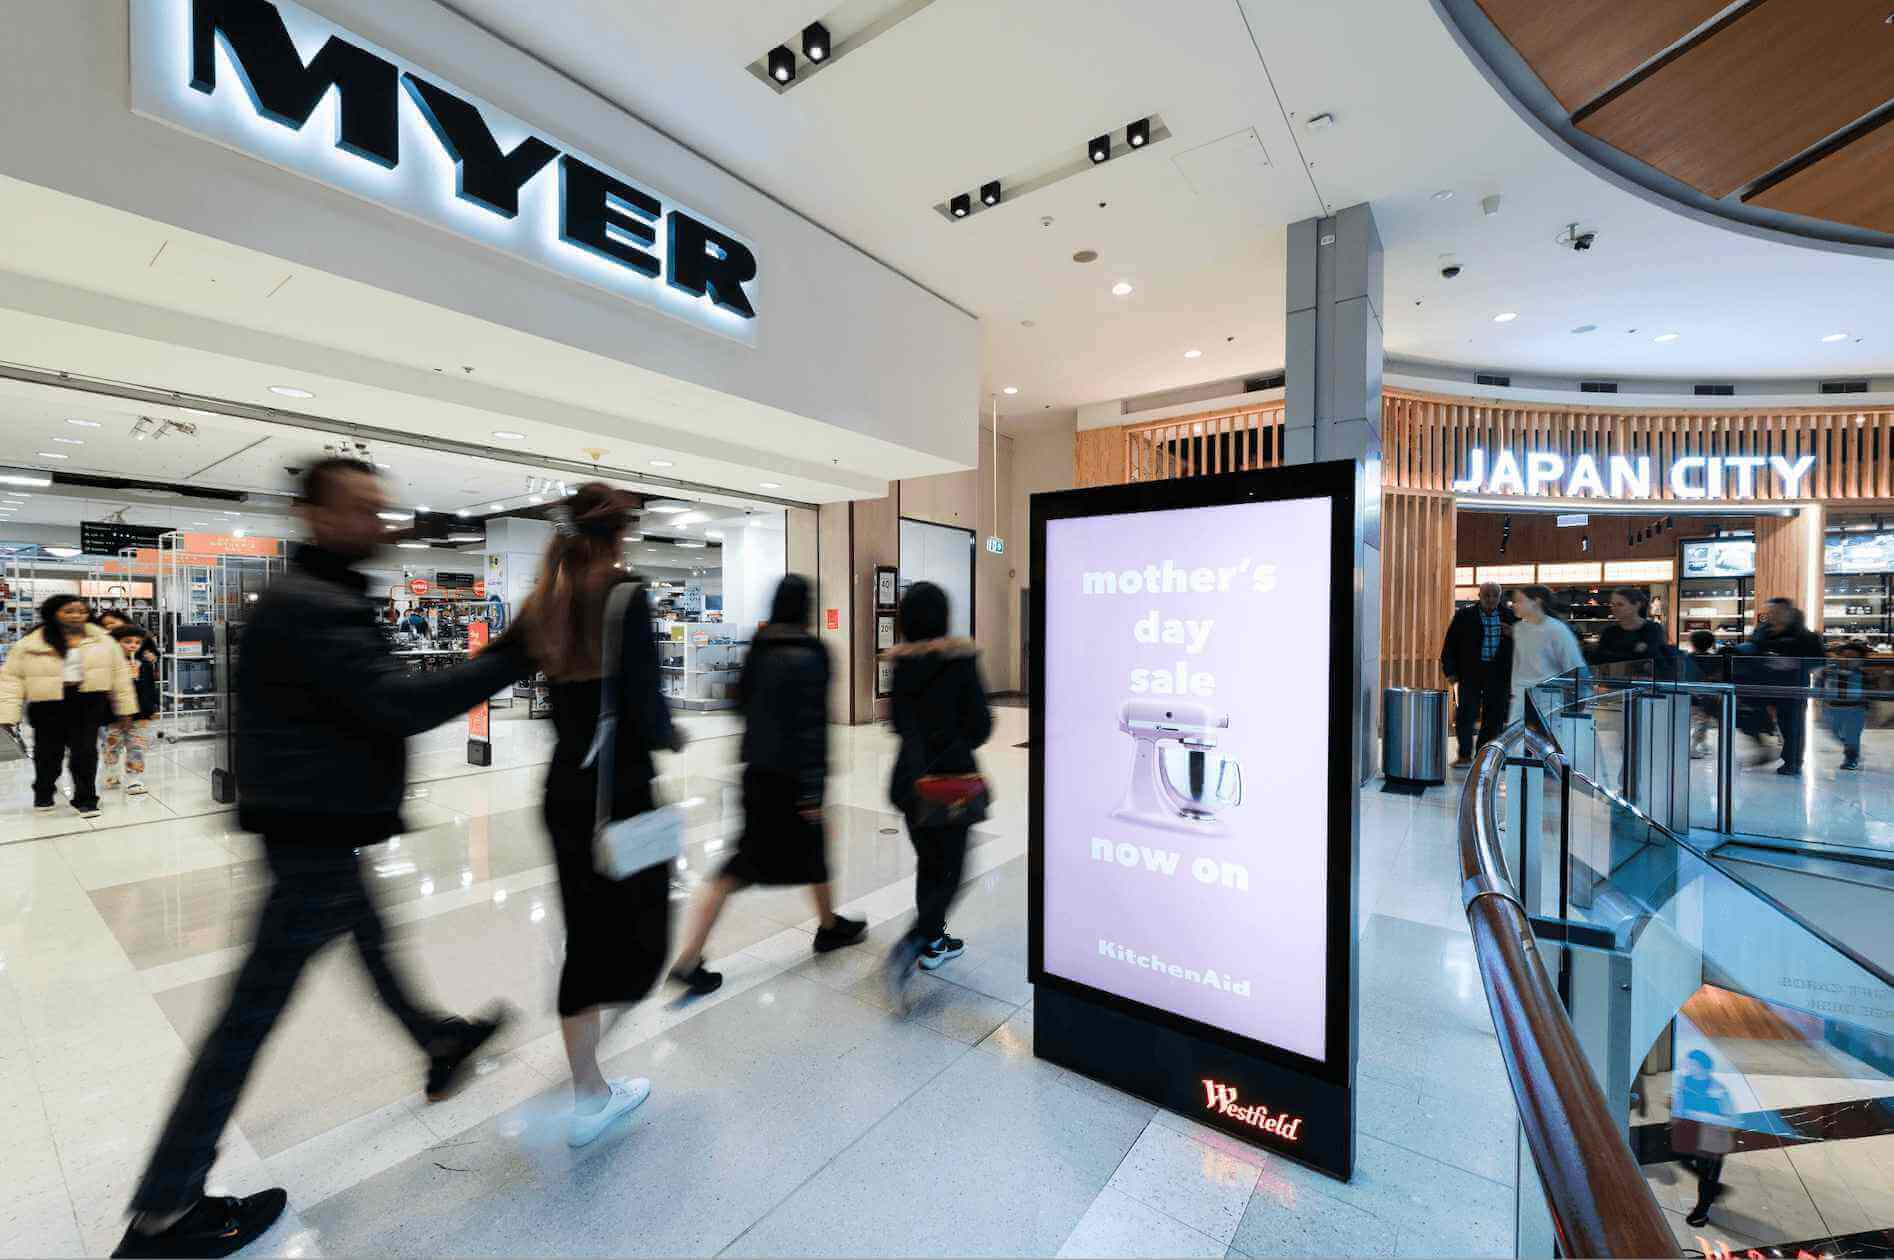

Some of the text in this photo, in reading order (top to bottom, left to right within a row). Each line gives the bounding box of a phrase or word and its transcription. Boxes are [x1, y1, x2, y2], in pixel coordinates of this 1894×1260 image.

[190, 0, 758, 319] MYER
[1453, 446, 1816, 500] JAPAN CITY
[1081, 557, 1278, 596] mother's
[1133, 610, 1215, 654] day
[1130, 662, 1216, 696] sale
[1090, 836, 1249, 892] now on
[1097, 938, 1252, 999] KitchenAid
[1201, 1078, 1303, 1142] Westfield
